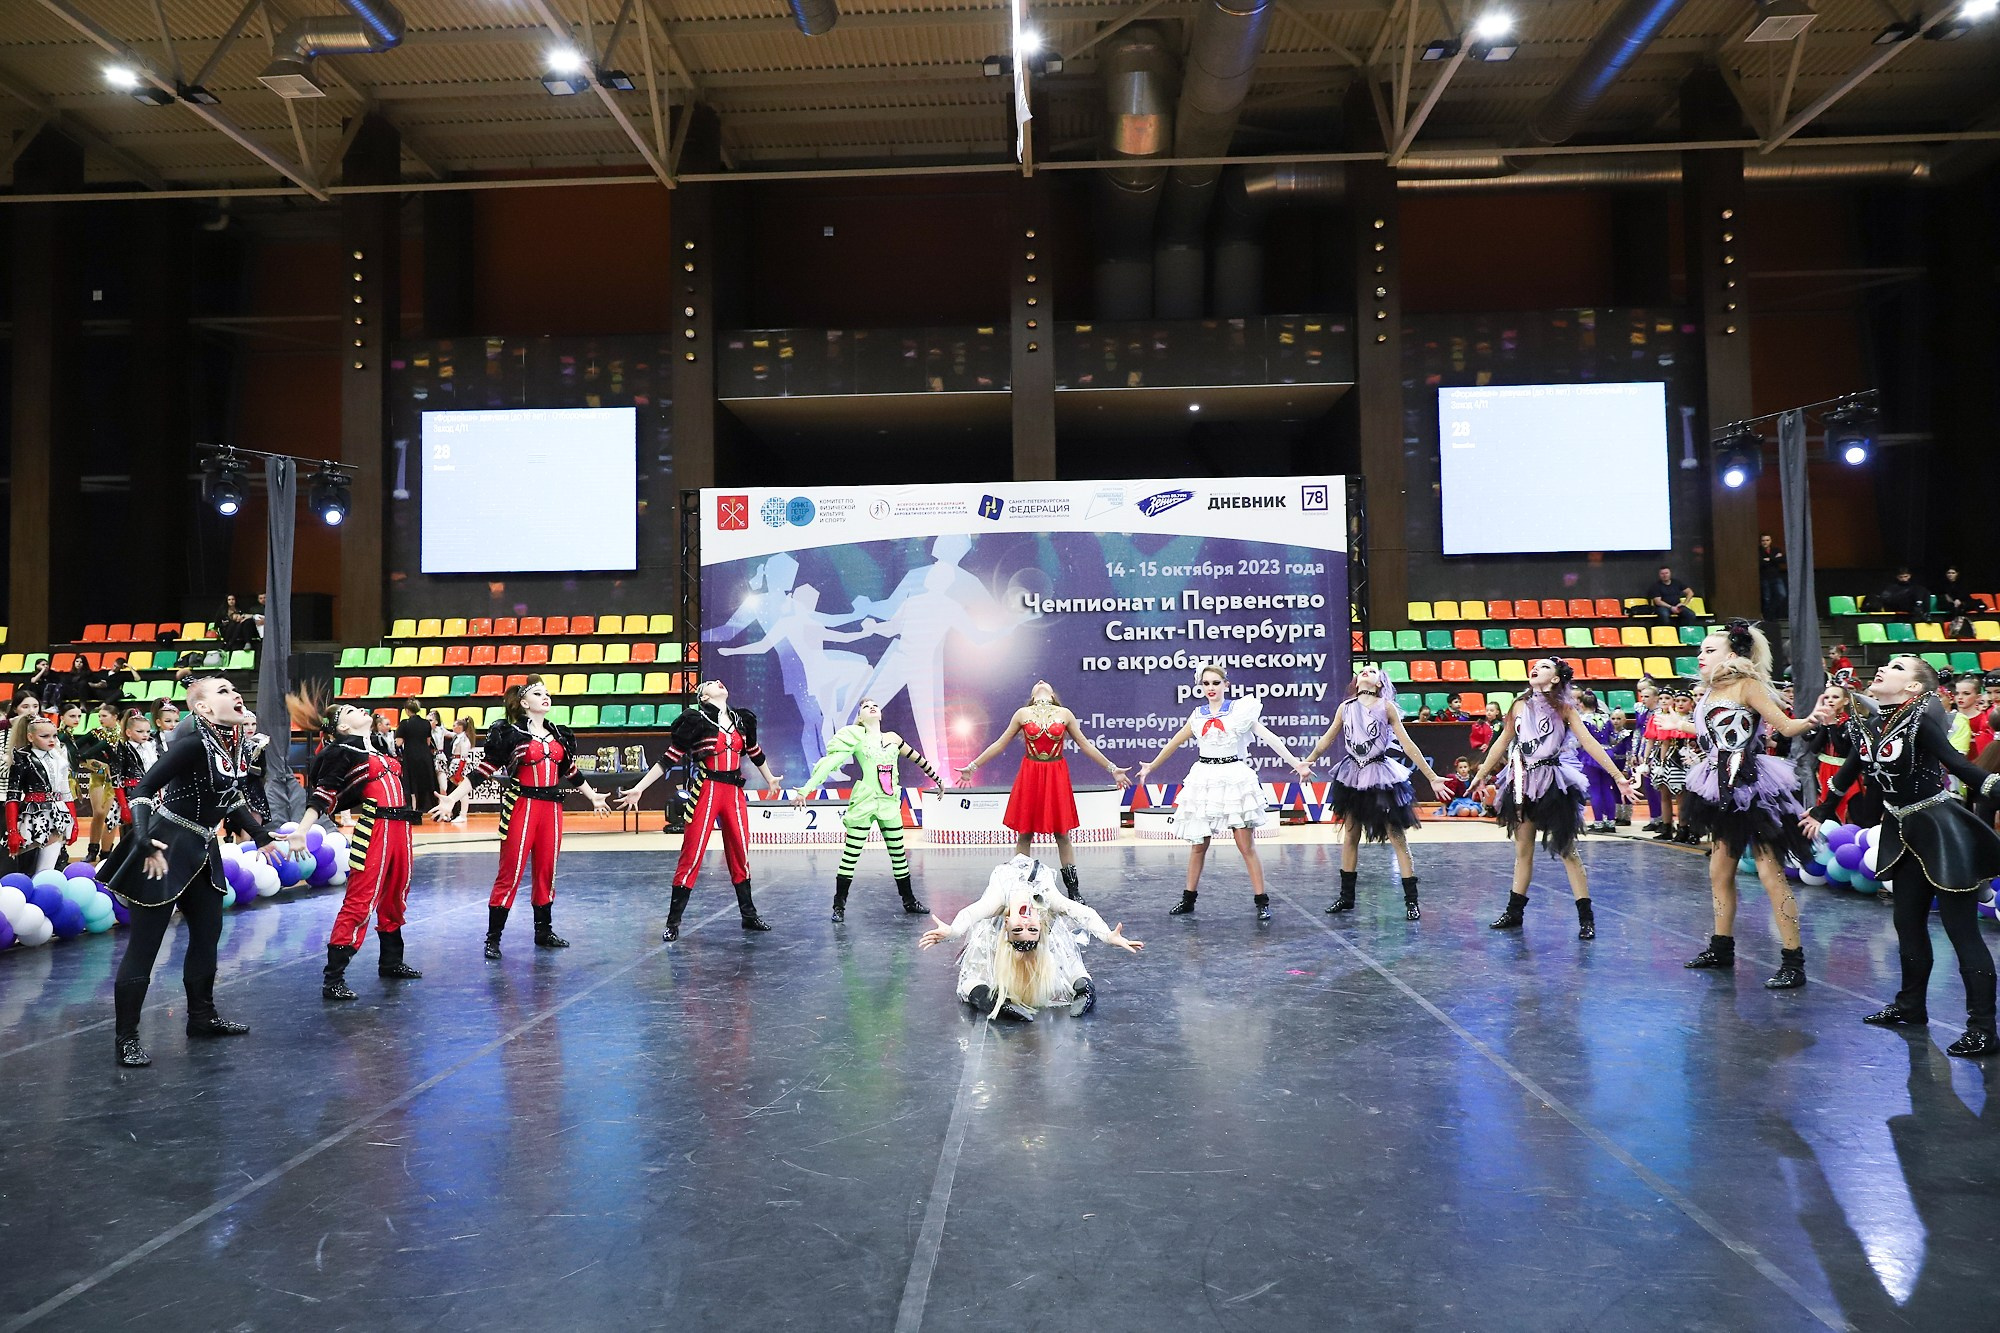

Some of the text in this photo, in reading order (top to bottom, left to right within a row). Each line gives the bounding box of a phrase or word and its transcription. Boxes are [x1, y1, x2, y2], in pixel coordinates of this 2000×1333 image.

[1451, 421, 1470, 437] 28
[433, 444, 450, 460] 28
[791, 501, 809, 509] САНКТ
[1207, 495, 1287, 511] ДНЕВНИК
[1305, 490, 1324, 506] 78
[1008, 504, 1070, 514] ФЕДЕРАЦИЯ
[1105, 562, 1125, 577] 14
[1138, 561, 1157, 576] 15
[1161, 560, 1234, 580] октября
[1238, 559, 1281, 575] 2023
[1285, 562, 1325, 577] года
[1023, 590, 1325, 614] Чемпионат и Первенство
[1105, 618, 1326, 643] Санкт-Петербурга
[1083, 649, 1327, 674] по акробатическому
[1177, 681, 1328, 703] ро-н-роллу
[1259, 714, 1330, 727] стиваль
[805, 809, 818, 830] 2
